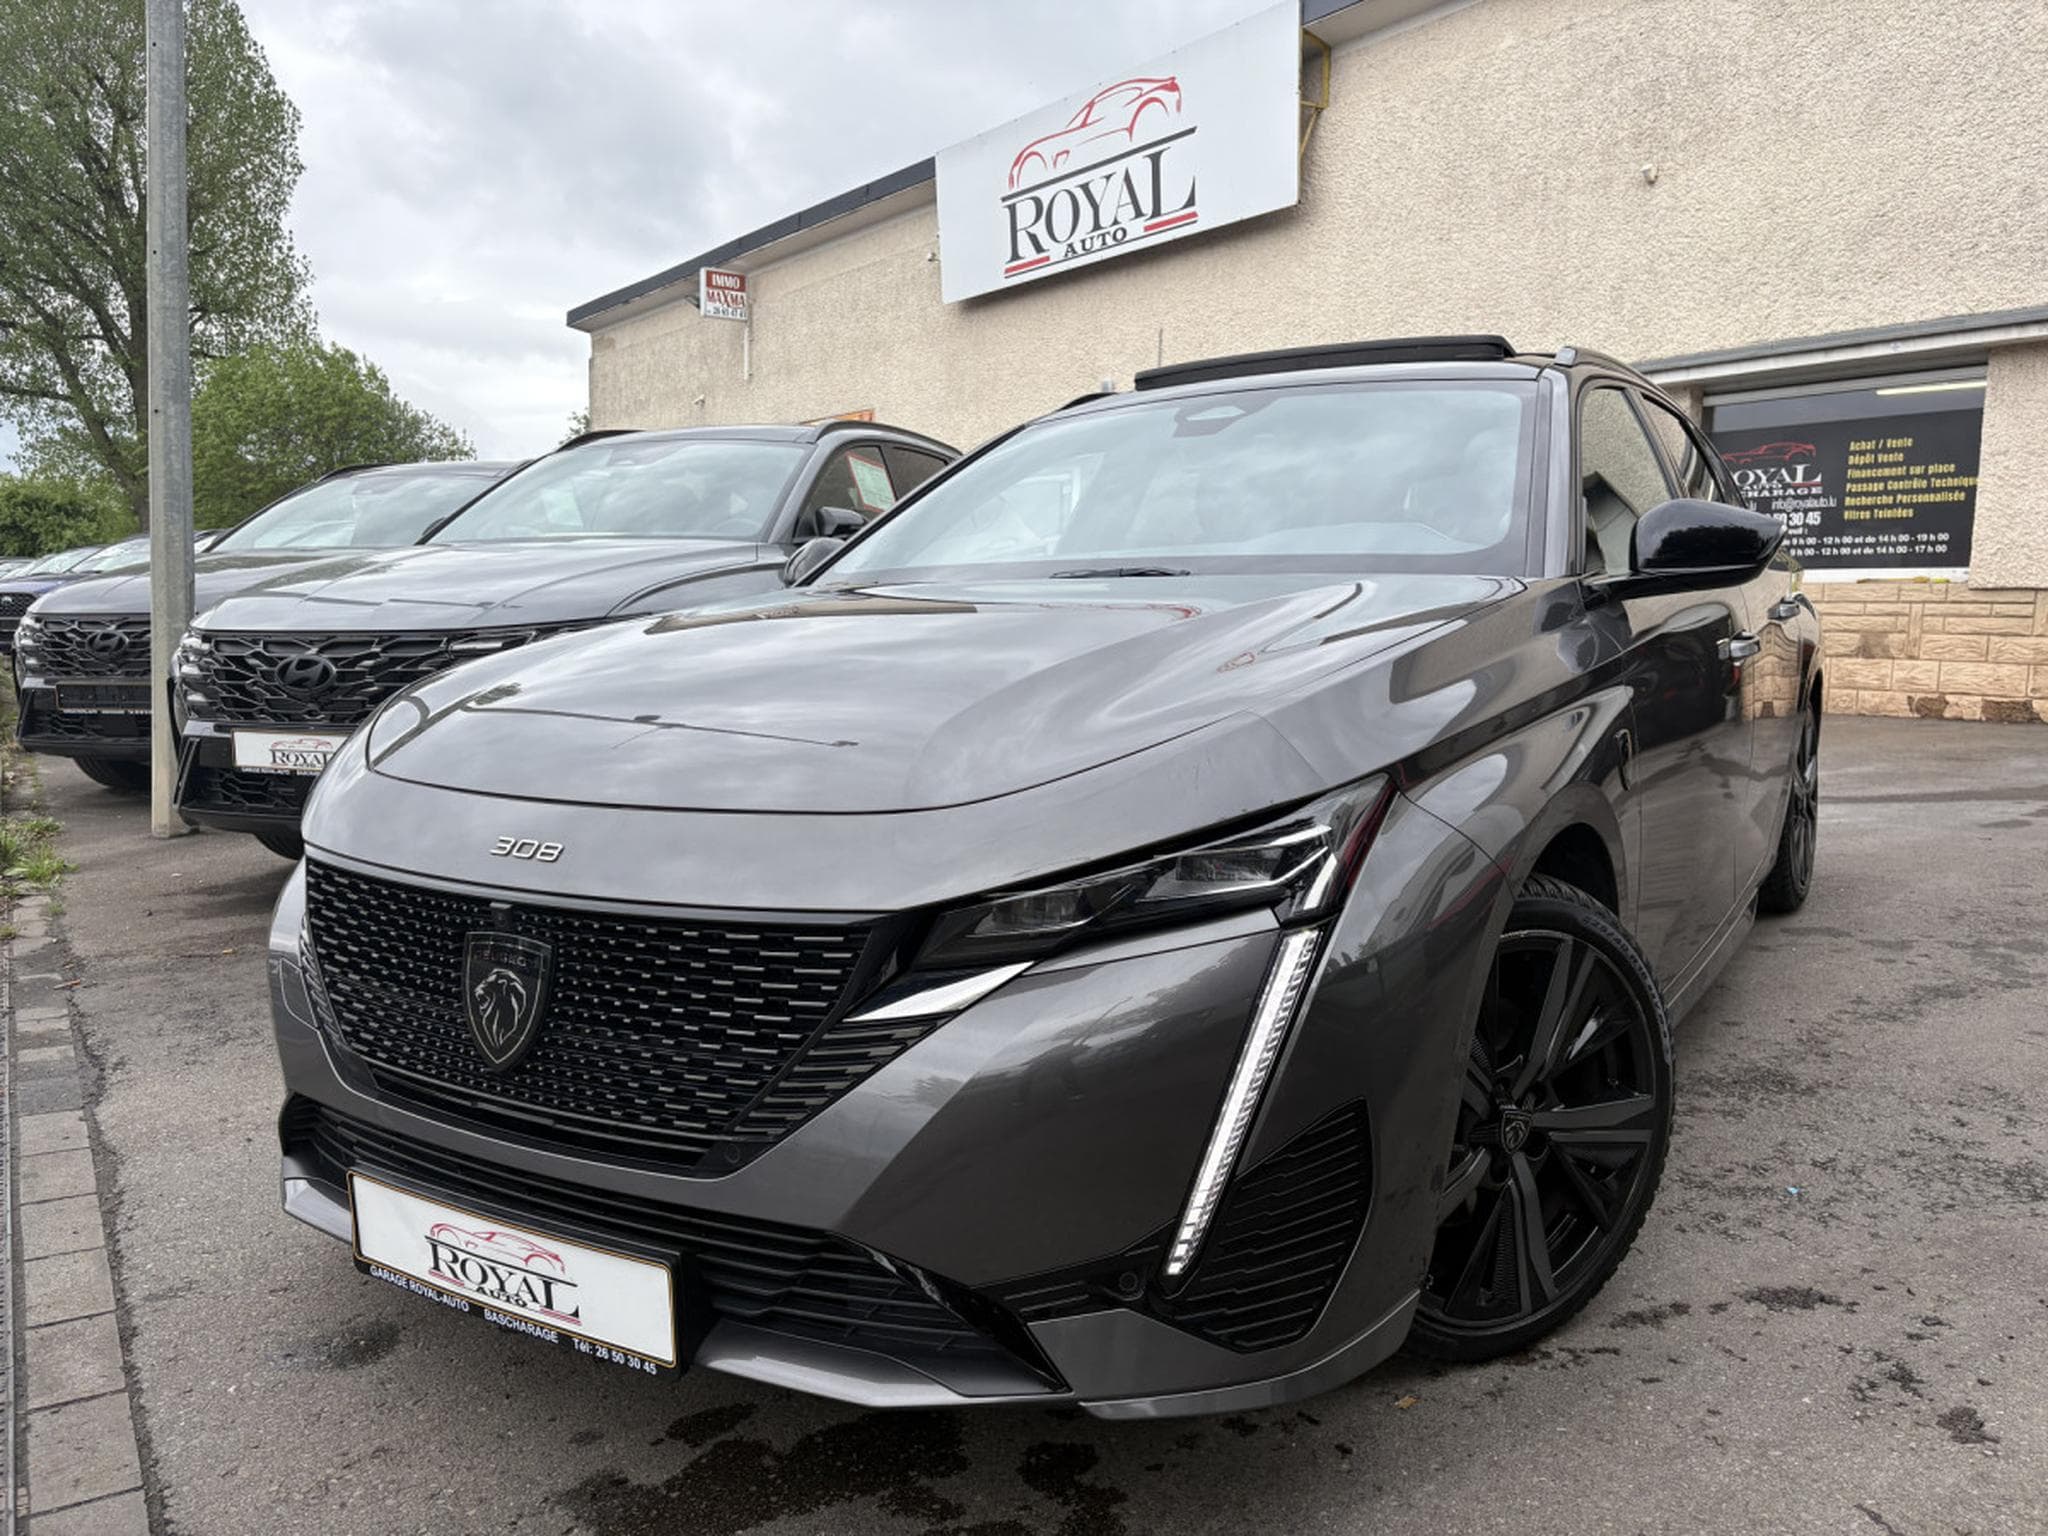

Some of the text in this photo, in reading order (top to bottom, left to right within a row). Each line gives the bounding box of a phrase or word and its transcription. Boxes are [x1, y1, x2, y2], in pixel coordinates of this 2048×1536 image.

[1004, 146, 1196, 263] ROYAL
[1064, 226, 1128, 258] AUTO
[712, 273, 740, 289] IMMO
[1849, 440, 1876, 451] Achat
[1886, 437, 1913, 448] Vente
[1877, 452, 1904, 463] Vente
[1732, 463, 1822, 487] OYAL
[1847, 463, 1956, 479] Financement sur place
[1846, 482, 1885, 492] Passage
[1845, 491, 1966, 506] Recherche Personnalisée
[1789, 512, 1804, 526] 30
[1805, 511, 1821, 525] 45
[1806, 537, 1816, 545] 00
[1823, 536, 1833, 544] 12
[1835, 536, 1840, 544] h
[1842, 536, 1853, 544] 00
[1890, 534, 1896, 542] h
[1898, 534, 1909, 542] 00
[1930, 533, 1935, 541] h
[1937, 533, 1949, 541] 00
[1797, 548, 1802, 556] h
[1804, 548, 1814, 556] 00
[1821, 547, 1831, 555] 12
[1833, 547, 1838, 555] h
[1840, 547, 1851, 555] 00
[1876, 546, 1887, 554] 14
[1896, 545, 1907, 553] 00
[1927, 544, 1933, 552] h
[1935, 544, 1947, 552] 00
[490, 836, 564, 862] 308
[428, 1243, 580, 1319] ROYAL
[476, 1285, 528, 1308] AUTO
[370, 1265, 409, 1289] GARAGE
[409, 1280, 470, 1312] ROYAL-AUTO
[483, 1308, 559, 1344] BASCHARAGE
[595, 1344, 609, 1360] 26
[612, 1350, 625, 1365] 50
[627, 1355, 641, 1370] 30
[643, 1361, 657, 1375] 45
